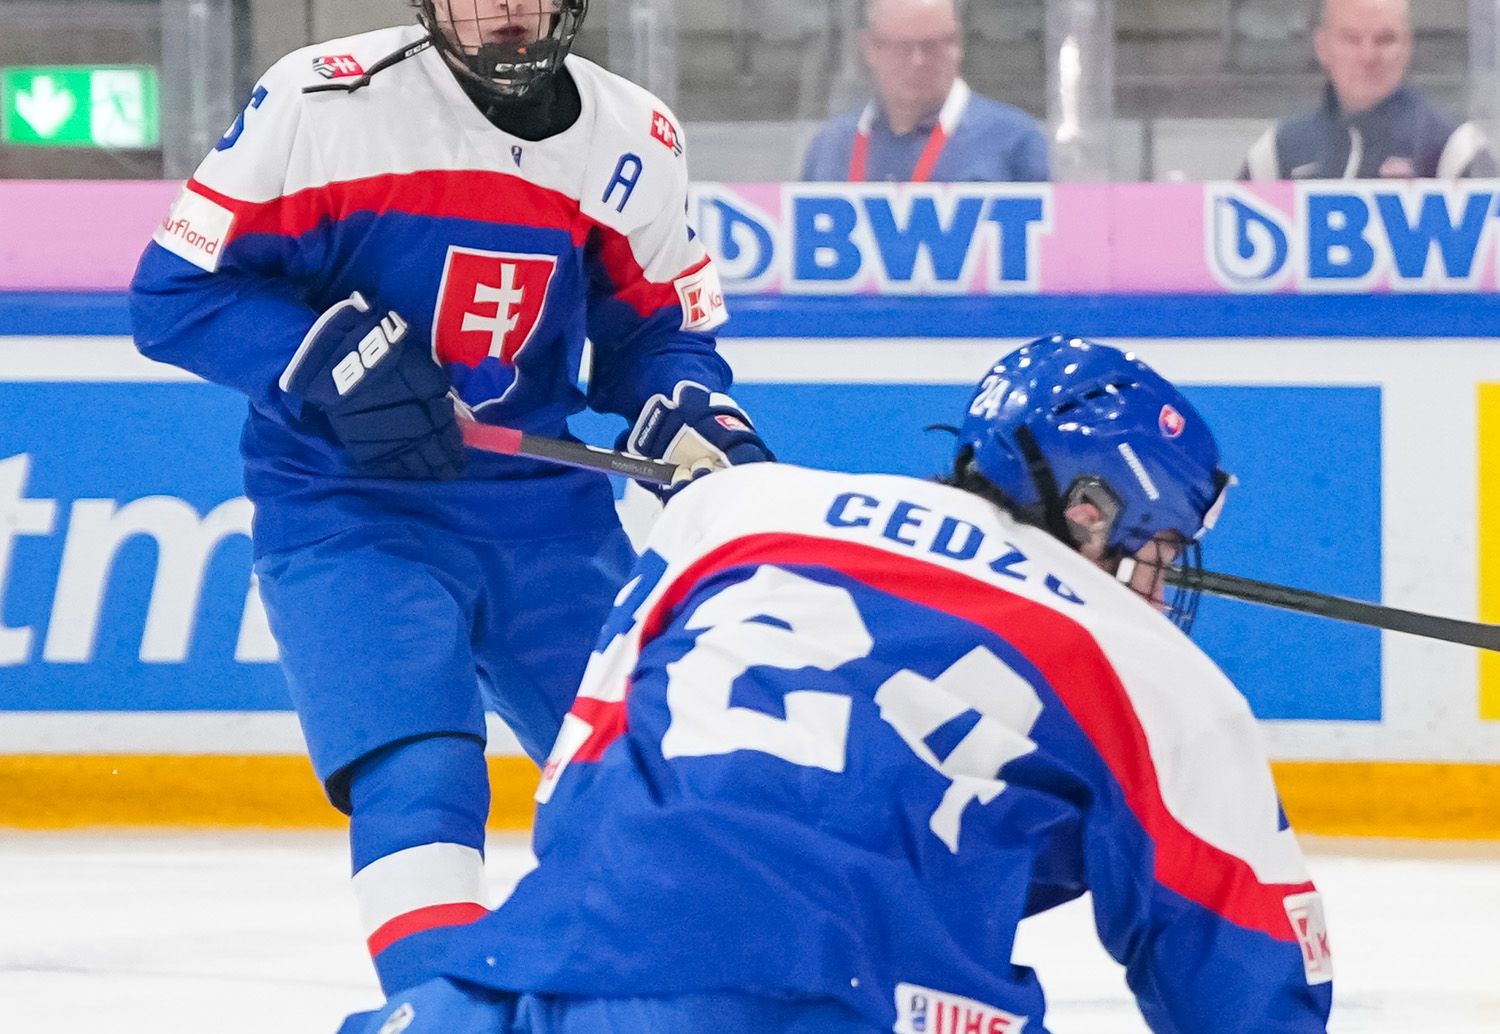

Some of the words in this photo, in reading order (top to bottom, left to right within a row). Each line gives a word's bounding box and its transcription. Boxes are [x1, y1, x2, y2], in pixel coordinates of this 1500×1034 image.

[601, 152, 643, 213] A
[794, 196, 1043, 281] BWT
[969, 374, 1011, 420] 24
[661, 563, 1045, 855] 24
